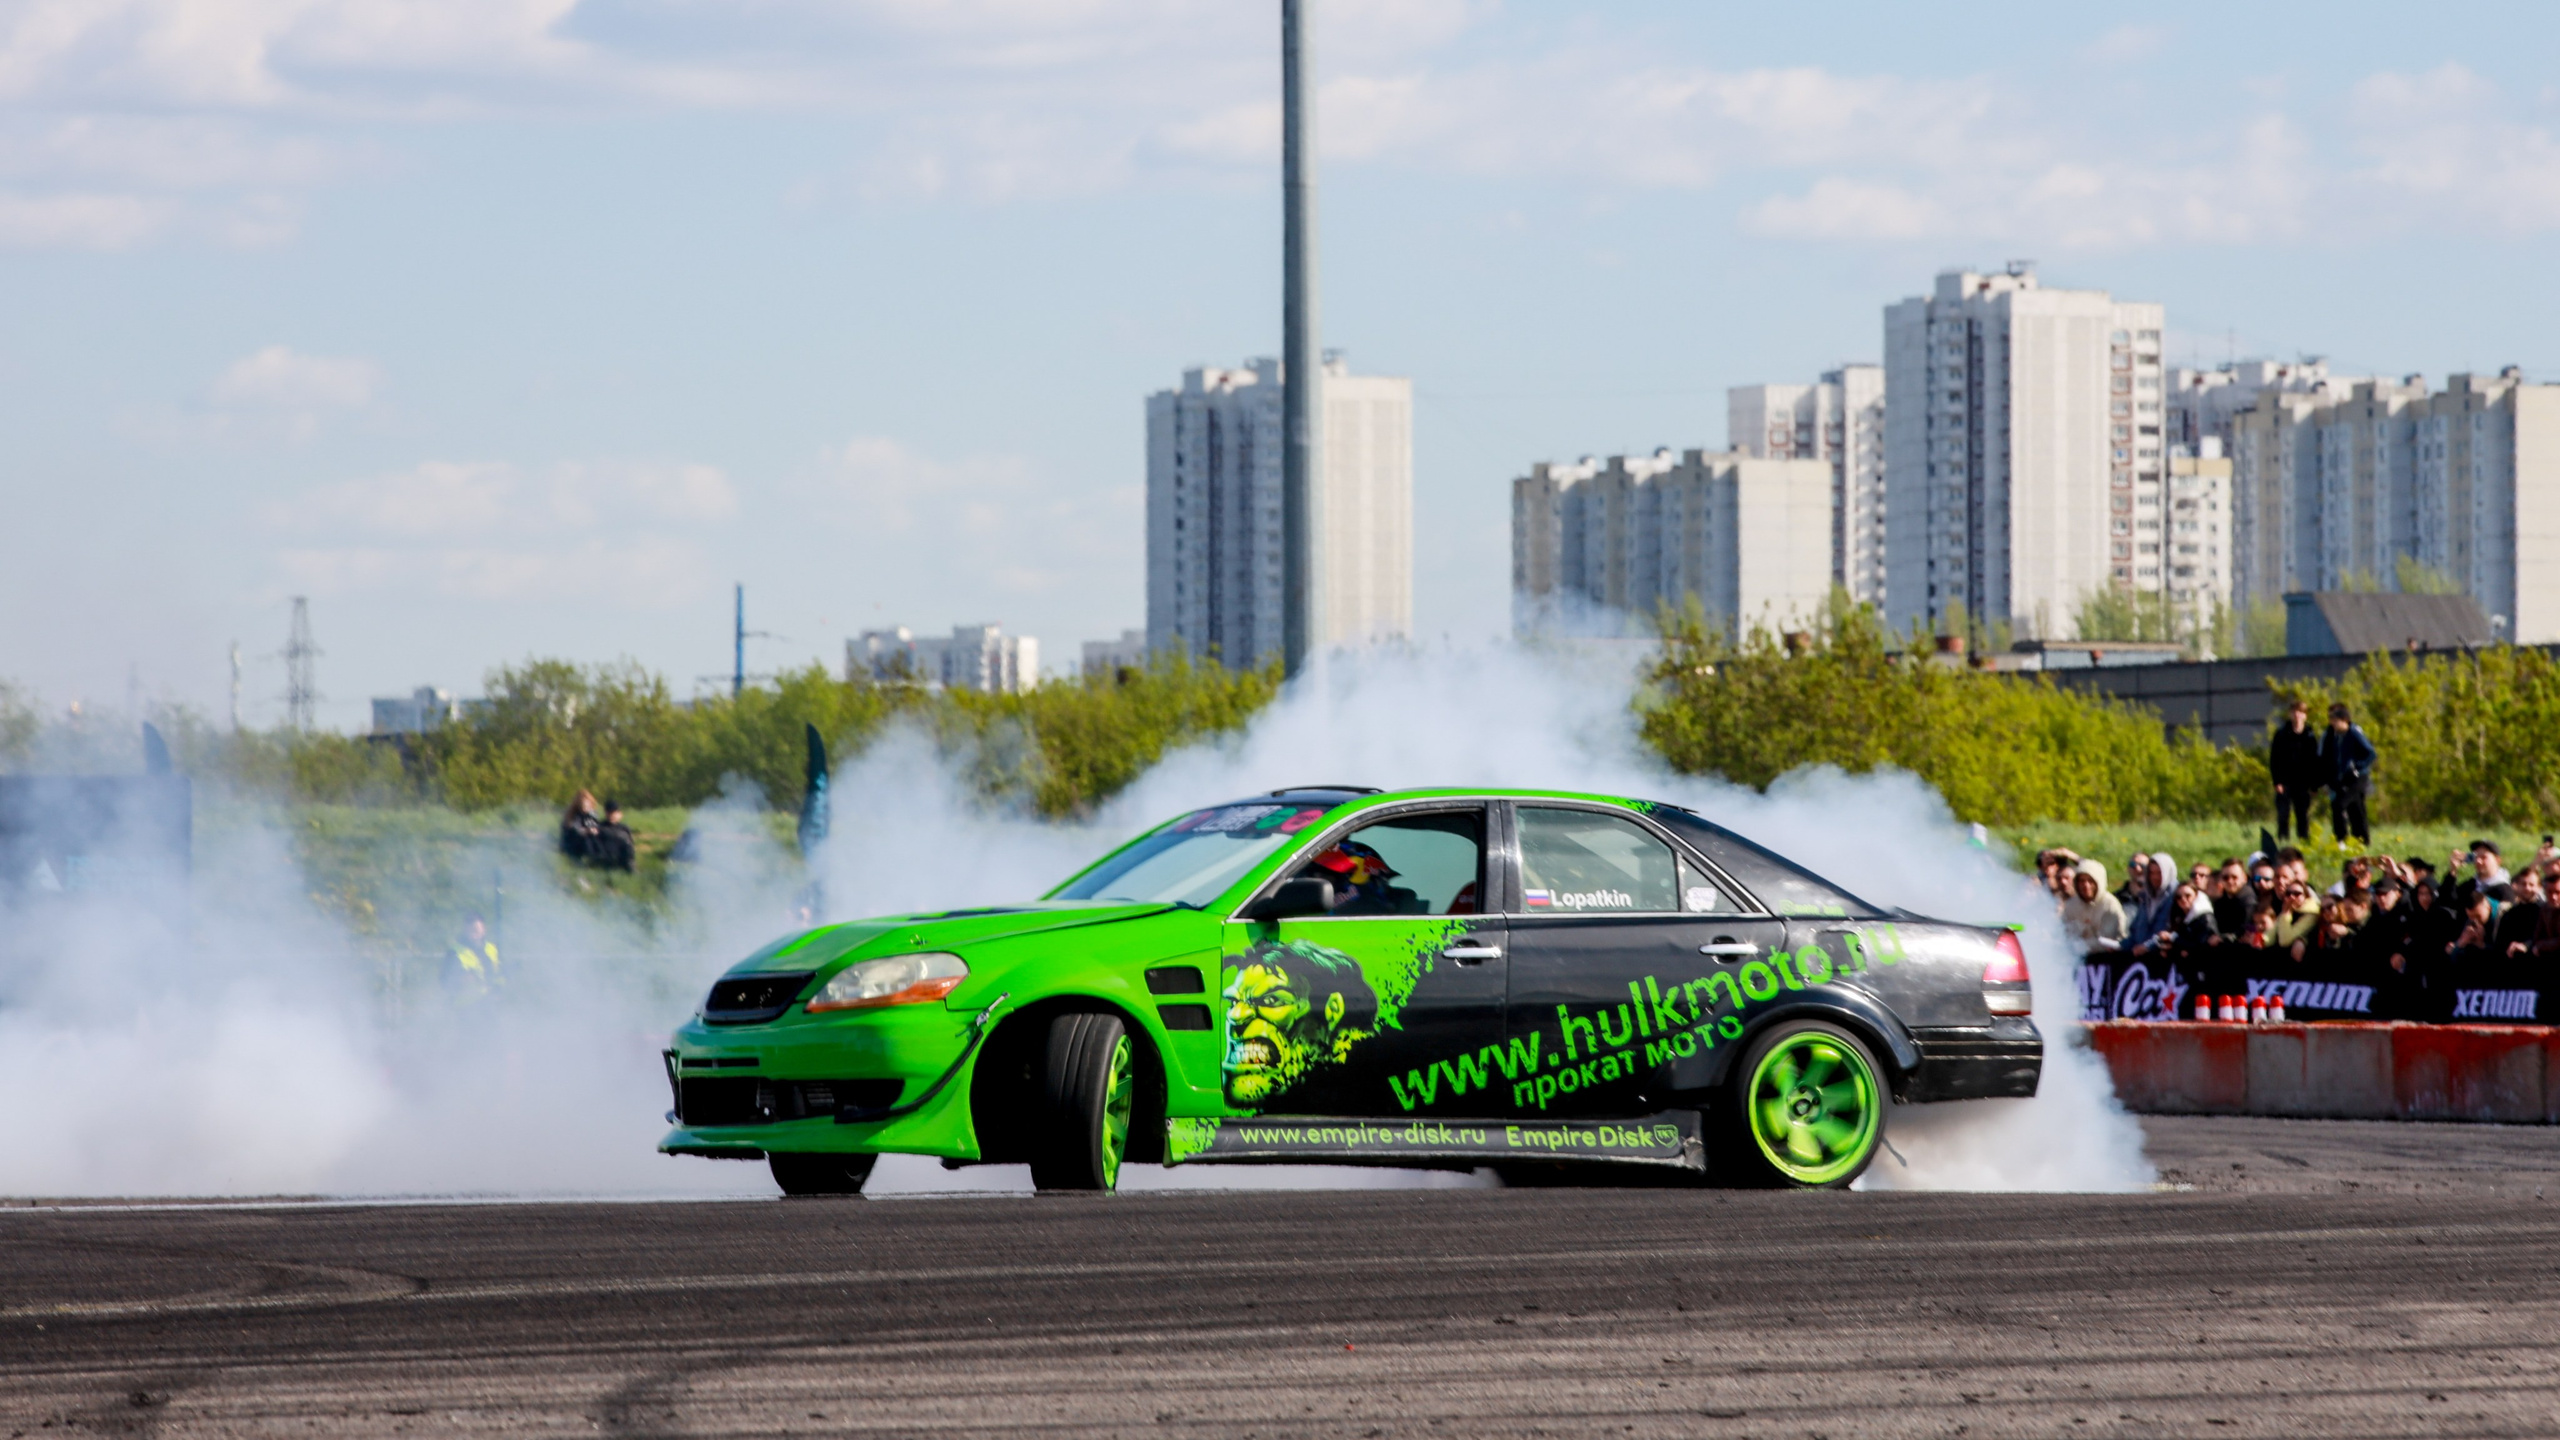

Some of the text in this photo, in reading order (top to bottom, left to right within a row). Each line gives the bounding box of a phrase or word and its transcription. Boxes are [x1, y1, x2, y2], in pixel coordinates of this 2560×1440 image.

[1549, 889, 1632, 911] Lopatkin
[1387, 922, 1908, 1111] www.hulkmoto.ru
[2452, 989, 2539, 1019] XENUM
[1512, 1049, 1636, 1110] прокат
[1239, 1122, 1487, 1149] www.empire-disk.ru
[1505, 1125, 1656, 1151] Empire Disk
